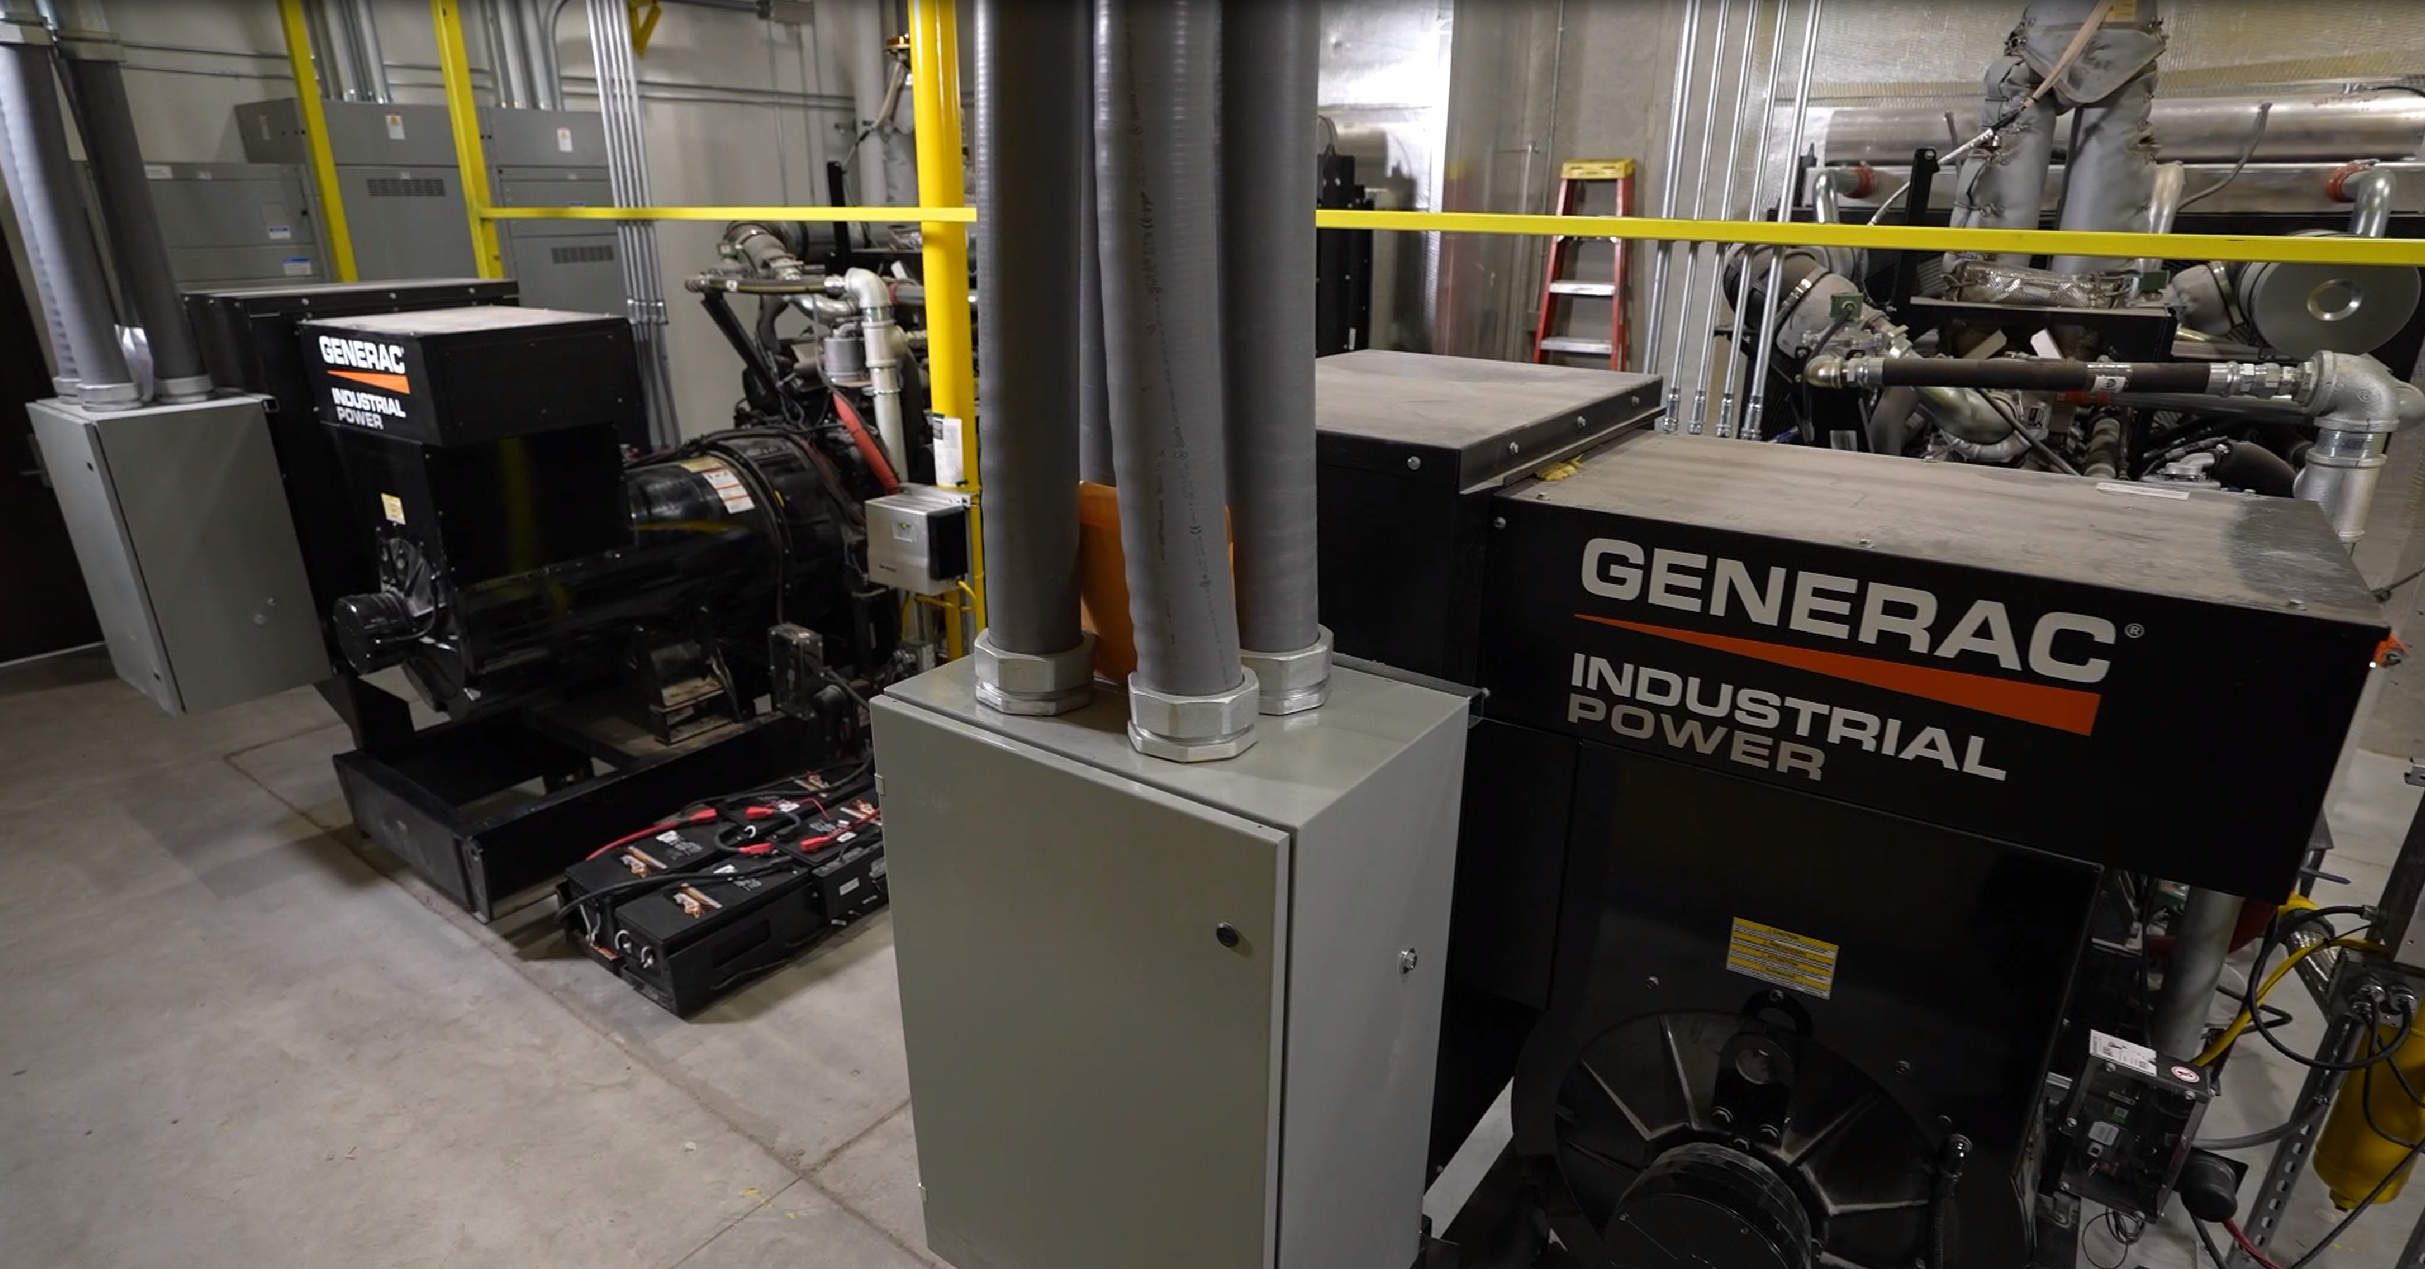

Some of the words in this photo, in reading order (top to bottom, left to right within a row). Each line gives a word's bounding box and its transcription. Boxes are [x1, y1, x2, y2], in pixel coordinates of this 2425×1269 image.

[319, 335, 405, 374] GENERAC
[331, 387, 406, 418] INDUSTRIAL
[336, 406, 384, 430] POWER
[1582, 538, 2116, 683] GENERAC
[1567, 692, 1825, 781] POWER
[1571, 653, 2006, 781] INDUSTRIAL
